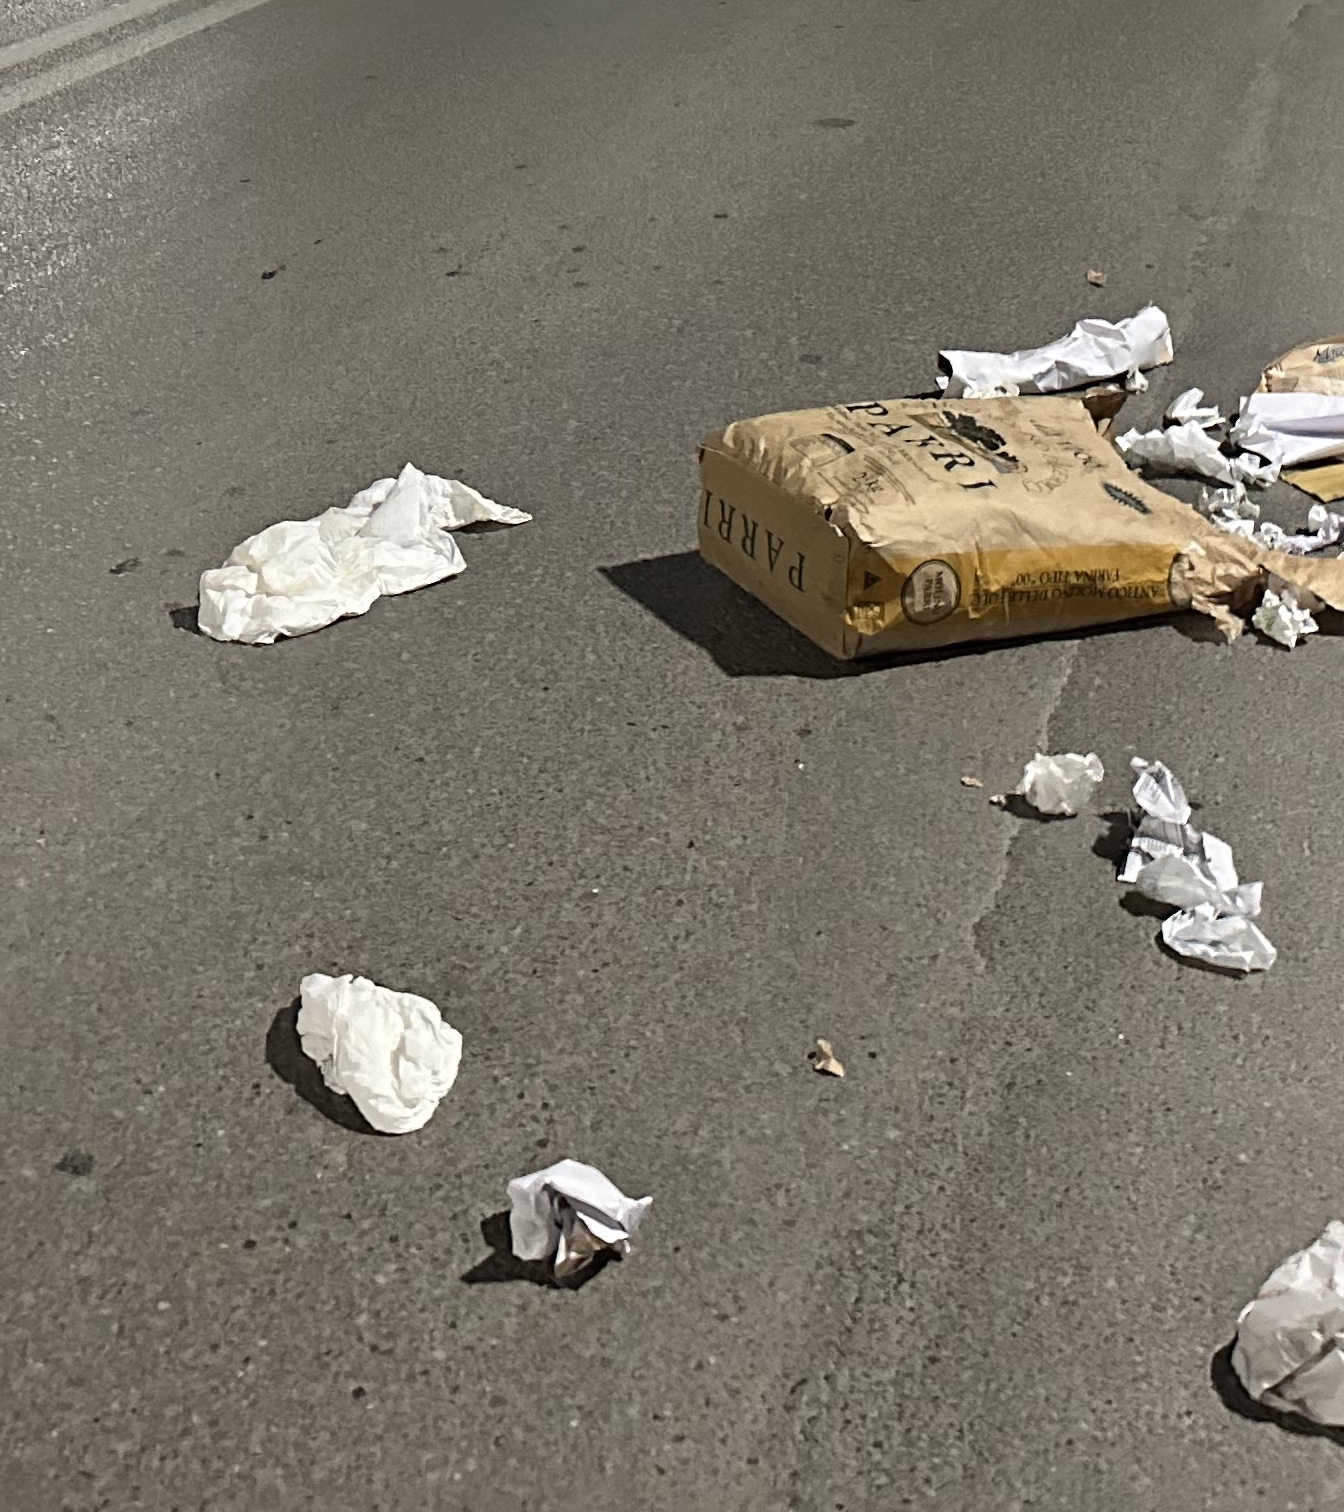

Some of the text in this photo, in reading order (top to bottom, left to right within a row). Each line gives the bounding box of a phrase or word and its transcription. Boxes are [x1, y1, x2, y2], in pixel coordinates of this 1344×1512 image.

[846, 402, 998, 493] PARRI
[703, 489, 806, 593] PARRI
[1073, 568, 1120, 582] FARINA
[1108, 585, 1159, 599] ANTICO
